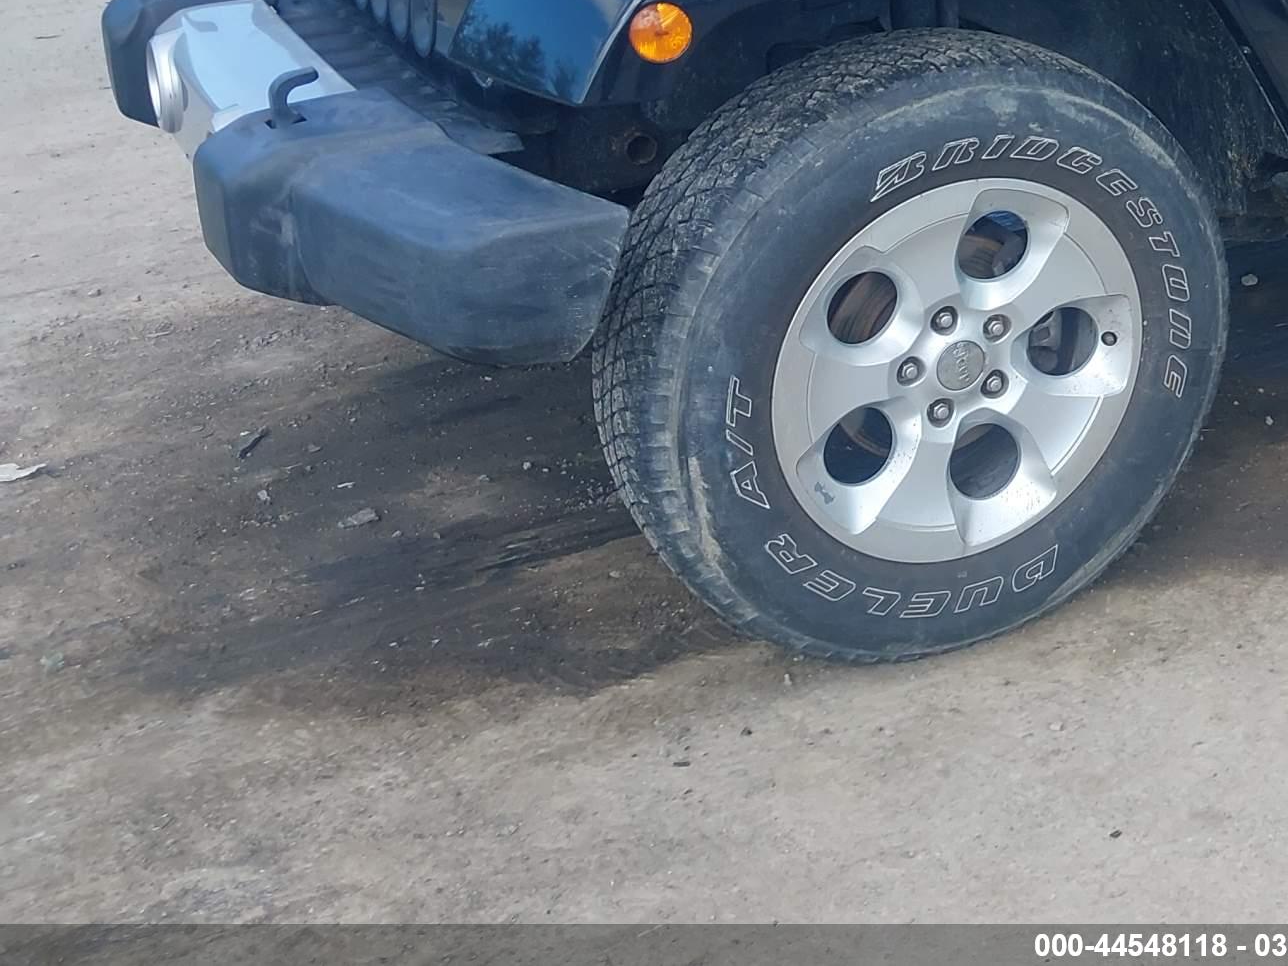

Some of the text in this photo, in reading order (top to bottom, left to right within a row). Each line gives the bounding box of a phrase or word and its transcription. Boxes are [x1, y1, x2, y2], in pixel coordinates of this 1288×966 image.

[869, 133, 1192, 400] BRIDGESTONE
[727, 376, 1060, 619] DUELER A/T
